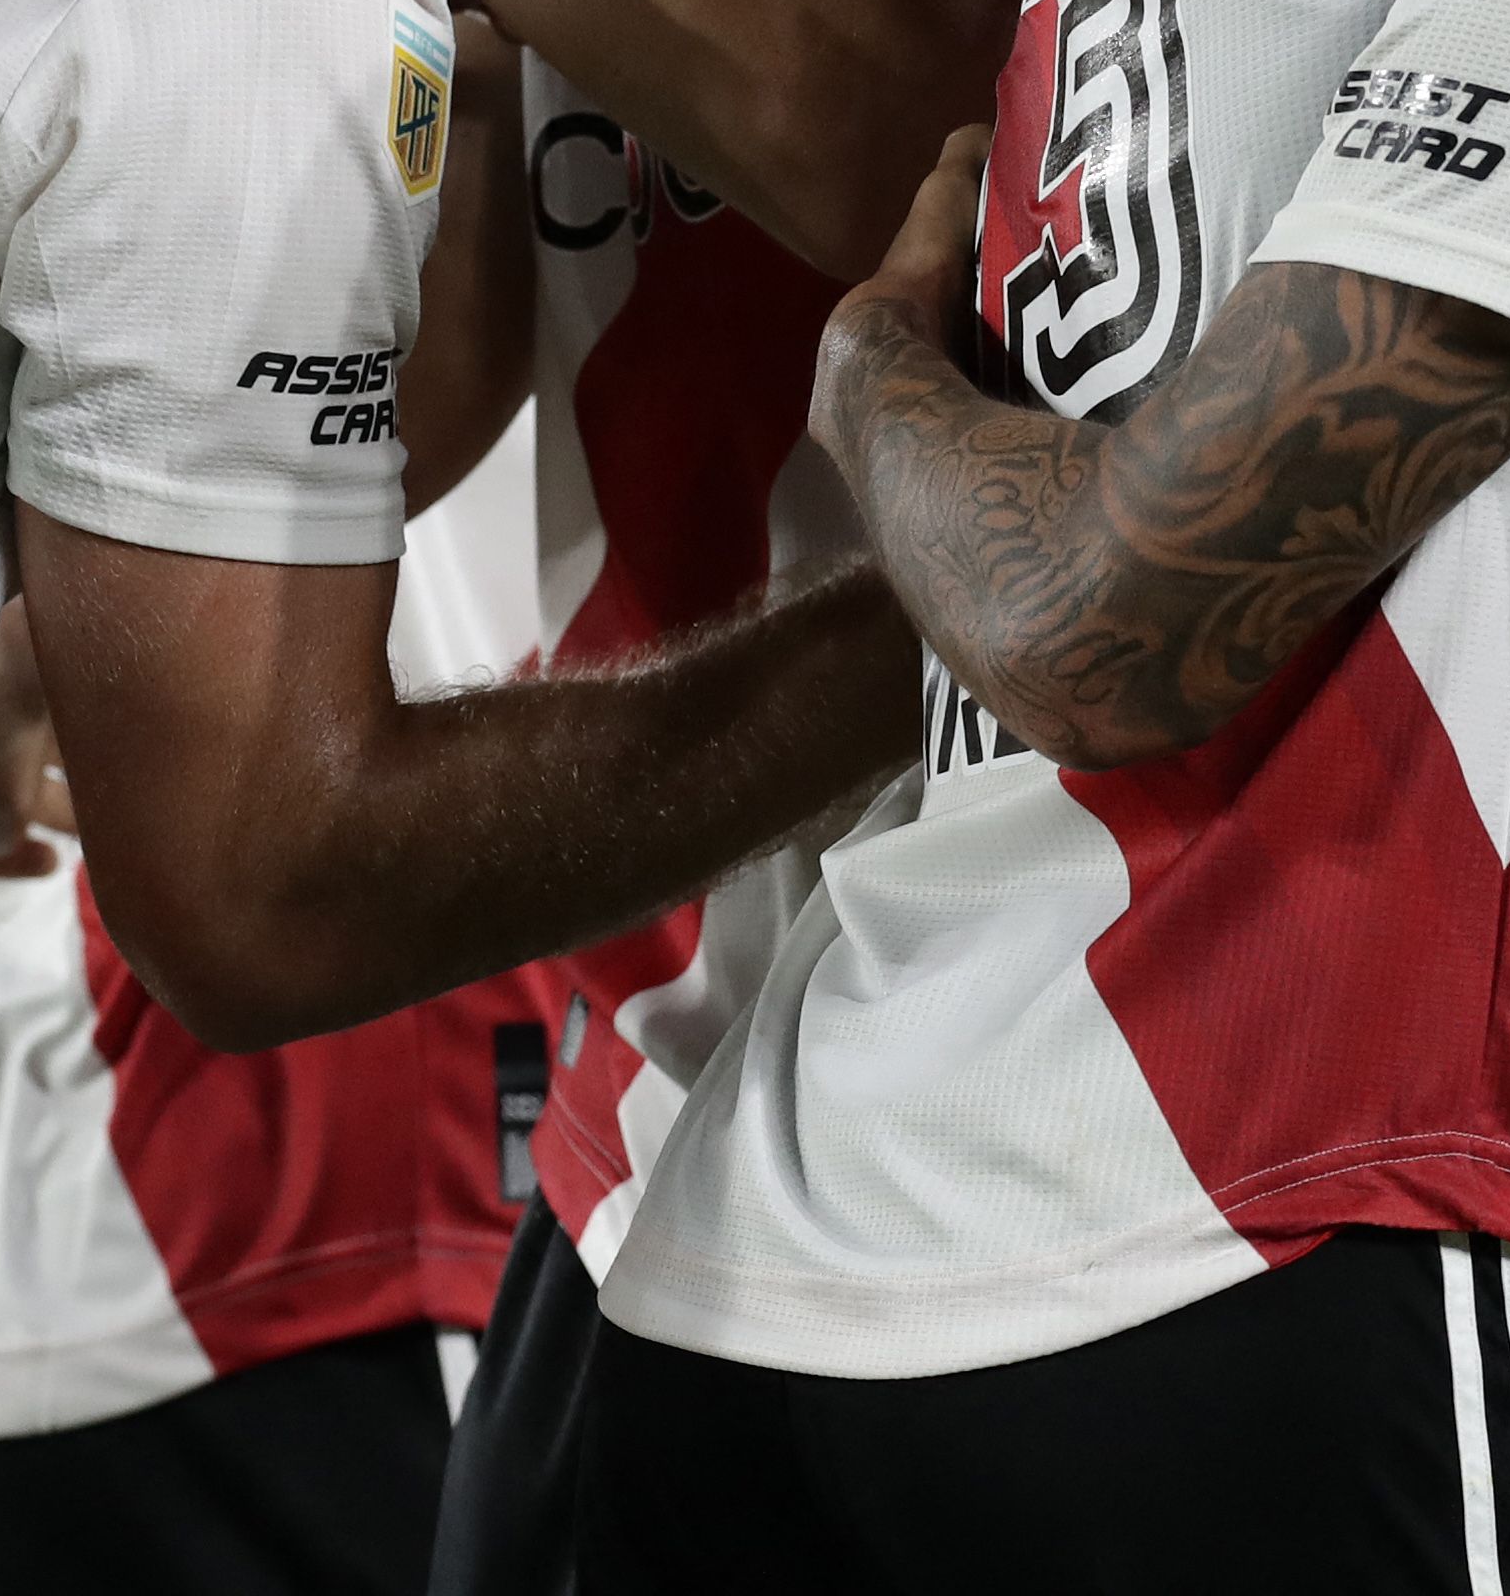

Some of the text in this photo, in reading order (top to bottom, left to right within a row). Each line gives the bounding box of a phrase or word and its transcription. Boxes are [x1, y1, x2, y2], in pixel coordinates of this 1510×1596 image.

[1334, 119, 1505, 181] CARD
[236, 348, 403, 395] ASSIS
[310, 398, 399, 445] CAR
